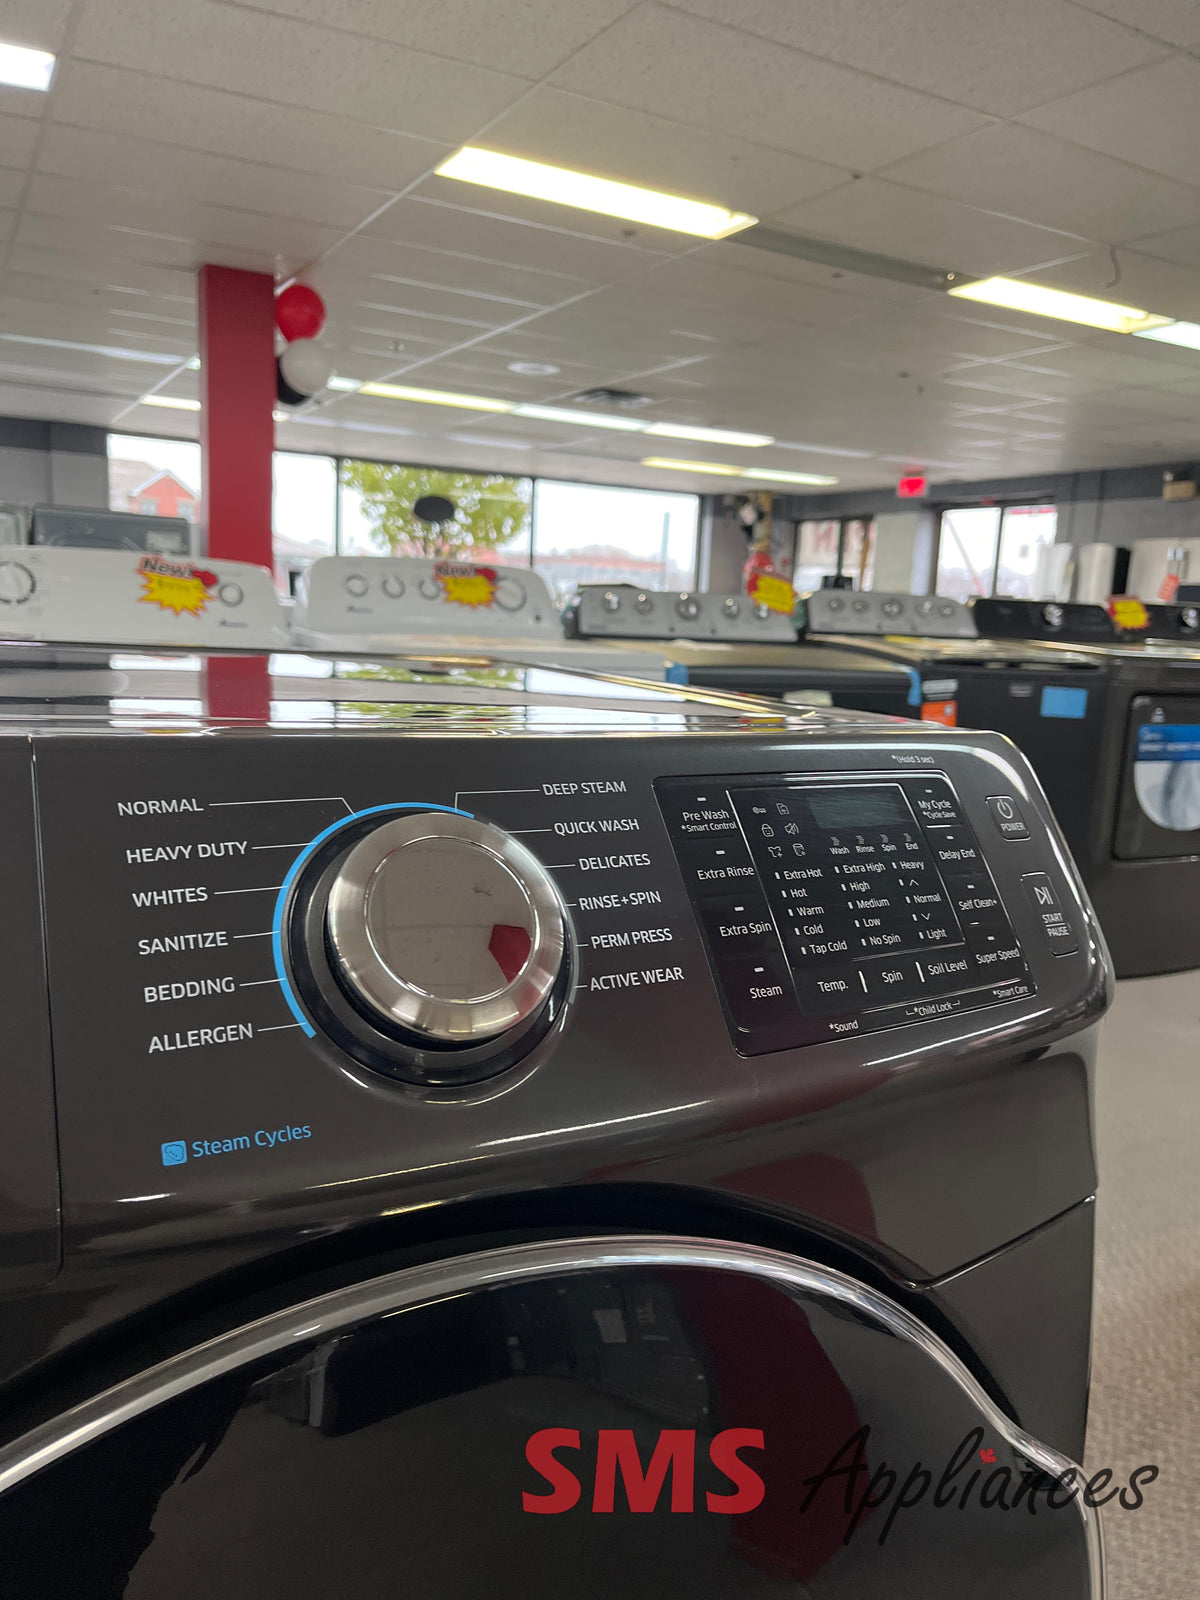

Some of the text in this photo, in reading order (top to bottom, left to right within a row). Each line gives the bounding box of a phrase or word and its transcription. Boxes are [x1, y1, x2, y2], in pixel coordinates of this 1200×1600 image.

[542, 781, 627, 796] DEEP STEAM
[117, 798, 204, 816] NORMAL
[918, 800, 952, 810] My Cycle
[682, 809, 730, 822] Pre Wash
[554, 819, 640, 837] QUICK WASH
[710, 821, 737, 831] Control
[1000, 822, 1026, 832] POWER
[126, 841, 248, 864] HEAVY DUTY
[829, 846, 850, 855] Wash
[855, 845, 875, 853] Rinse
[881, 843, 898, 852] Spin
[905, 842, 919, 851] End
[939, 849, 976, 860] Delay End
[578, 853, 651, 871] DELICATES
[842, 862, 886, 874] Extra High
[899, 860, 925, 870] Heavy
[697, 866, 755, 880] Extra Rinse
[783, 868, 823, 880] Extra Hot
[790, 887, 808, 898] Hot
[849, 881, 871, 892] High
[132, 886, 208, 908] WHITES
[578, 890, 662, 911] RINSE+SPIN
[913, 892, 942, 903] Normal
[856, 898, 890, 909] Medium
[958, 900, 974, 911] Self
[796, 905, 825, 916] Warm
[862, 918, 881, 928] Low
[1041, 912, 1064, 923] START
[719, 921, 773, 937] Extra Spin
[803, 924, 824, 935] Cold
[926, 928, 948, 940] Light
[1046, 926, 1070, 937] PAUSE
[138, 930, 229, 955] SANITIZE
[590, 928, 673, 949] PERM PRESS
[869, 933, 902, 946] No Spin
[809, 940, 848, 955] Tap Cold
[975, 948, 1021, 964] Super Speed
[927, 959, 968, 976] Soil Level
[590, 966, 685, 991] ACTIVE WEAR
[881, 969, 904, 984] Spin
[143, 976, 236, 1003] BEDDING
[749, 985, 784, 999] Steam
[817, 979, 849, 993] Temp.
[1014, 984, 1029, 995] Care
[935, 1001, 953, 1013] Lock
[148, 1022, 254, 1054] ALLERGEN
[191, 1124, 312, 1158] Steam Cycles
